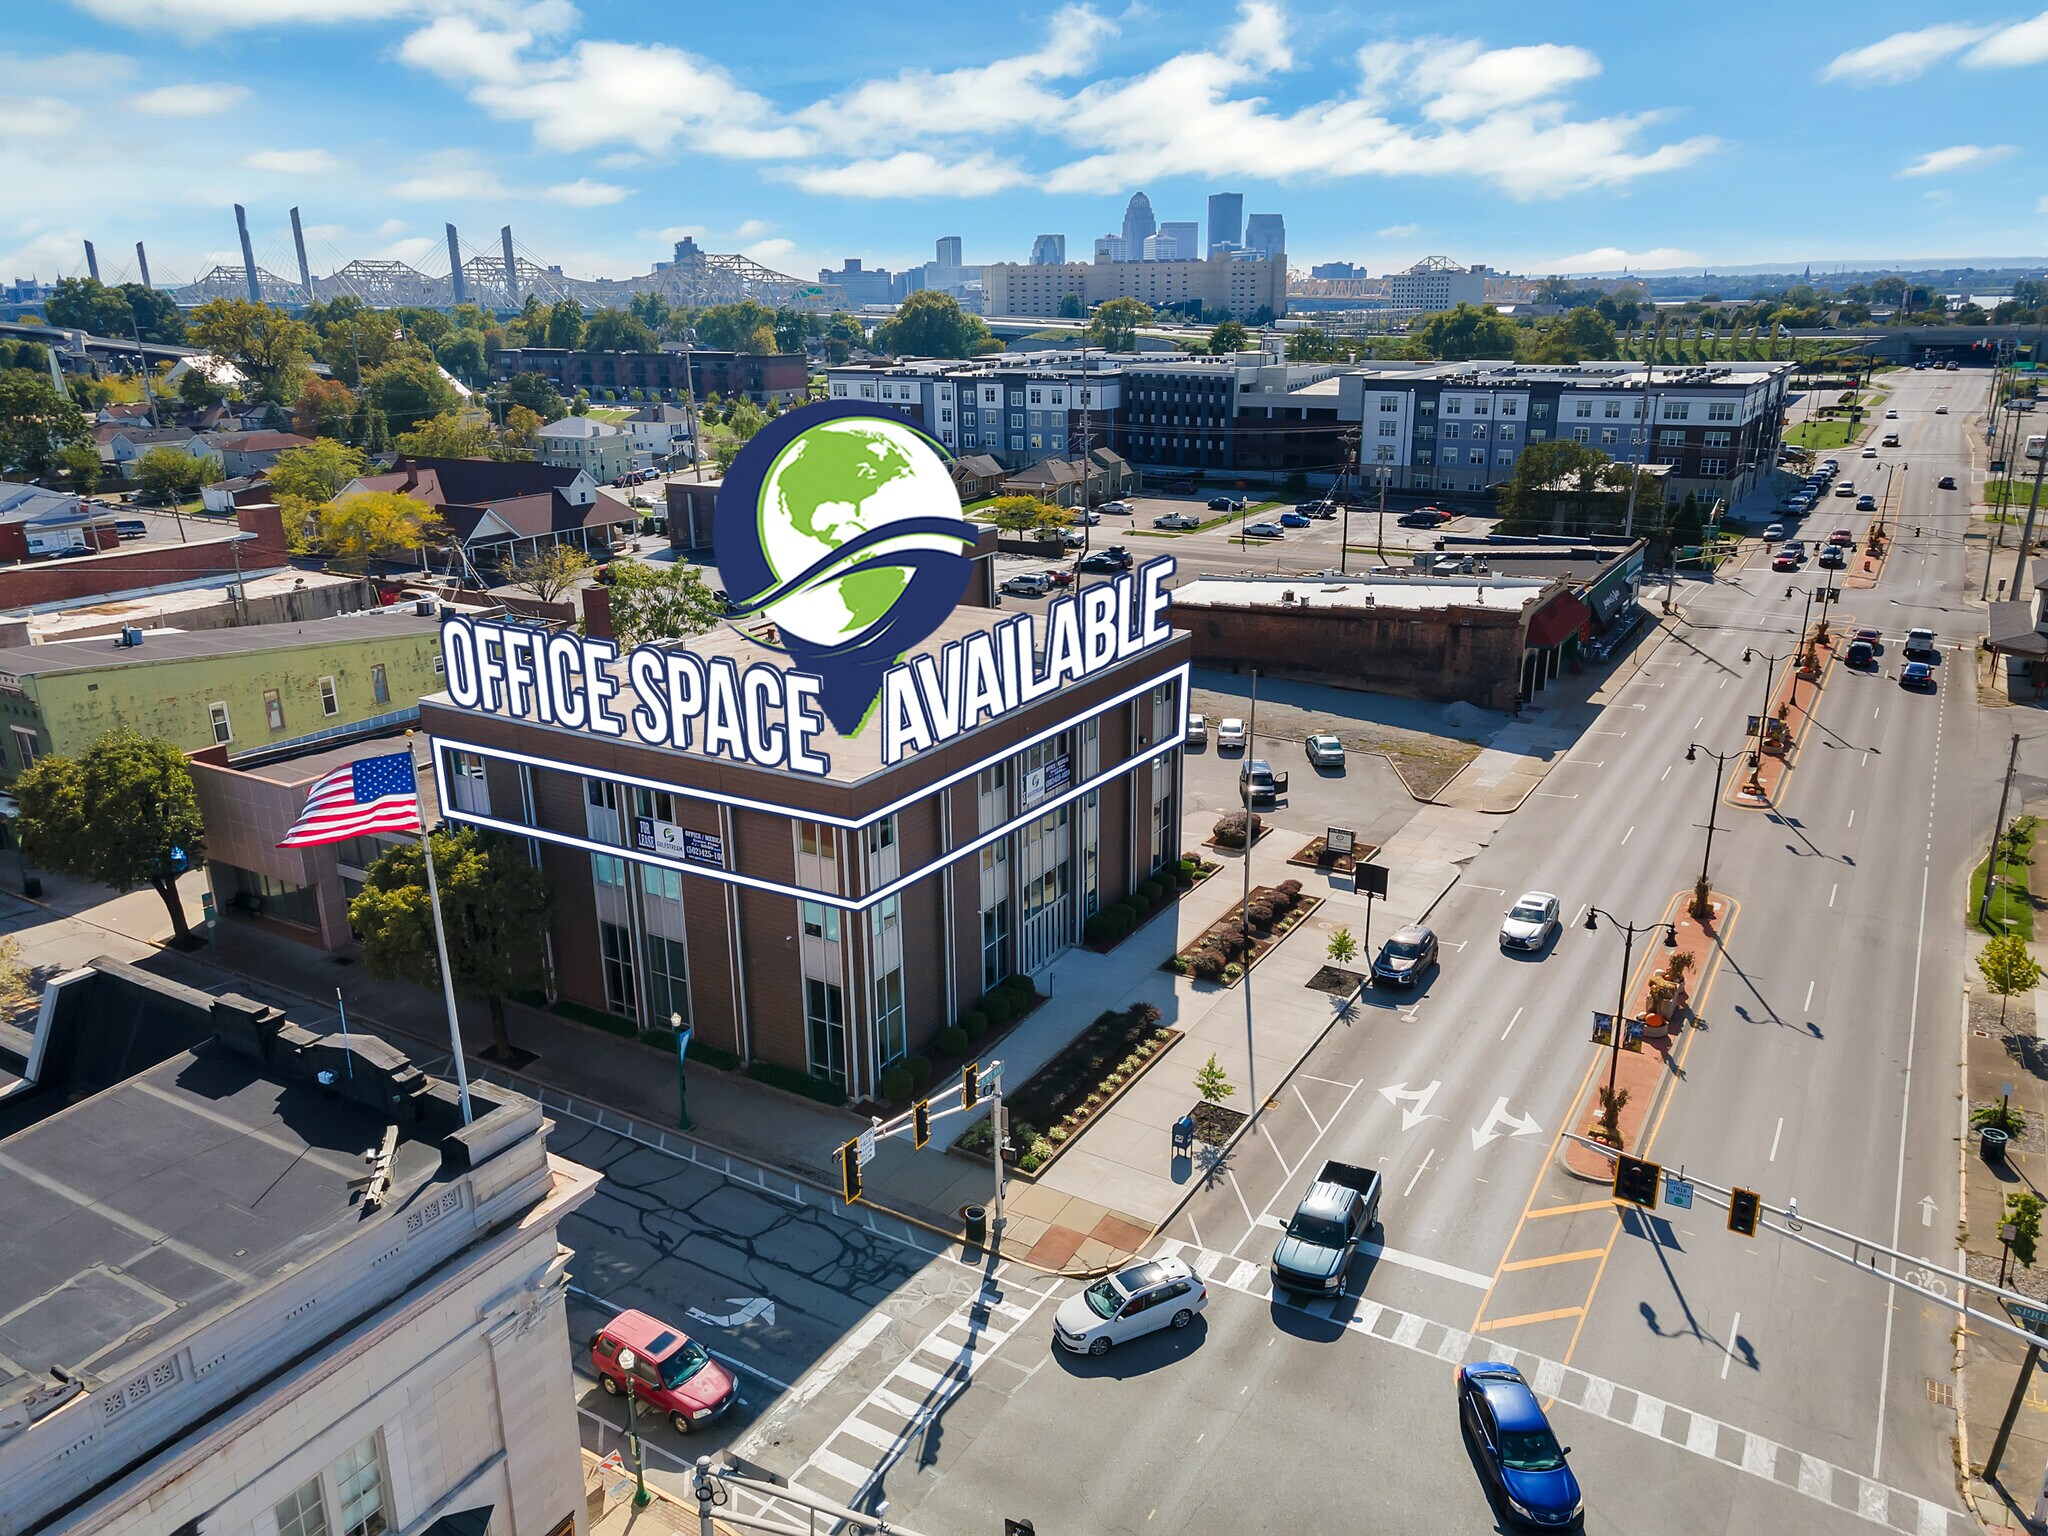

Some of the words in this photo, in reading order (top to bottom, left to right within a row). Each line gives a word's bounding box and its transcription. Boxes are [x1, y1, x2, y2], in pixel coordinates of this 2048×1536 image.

[640, 821, 651, 835] FOR
[638, 833, 655, 849] LEASE
[656, 841, 683, 852] GULFSTREAM
